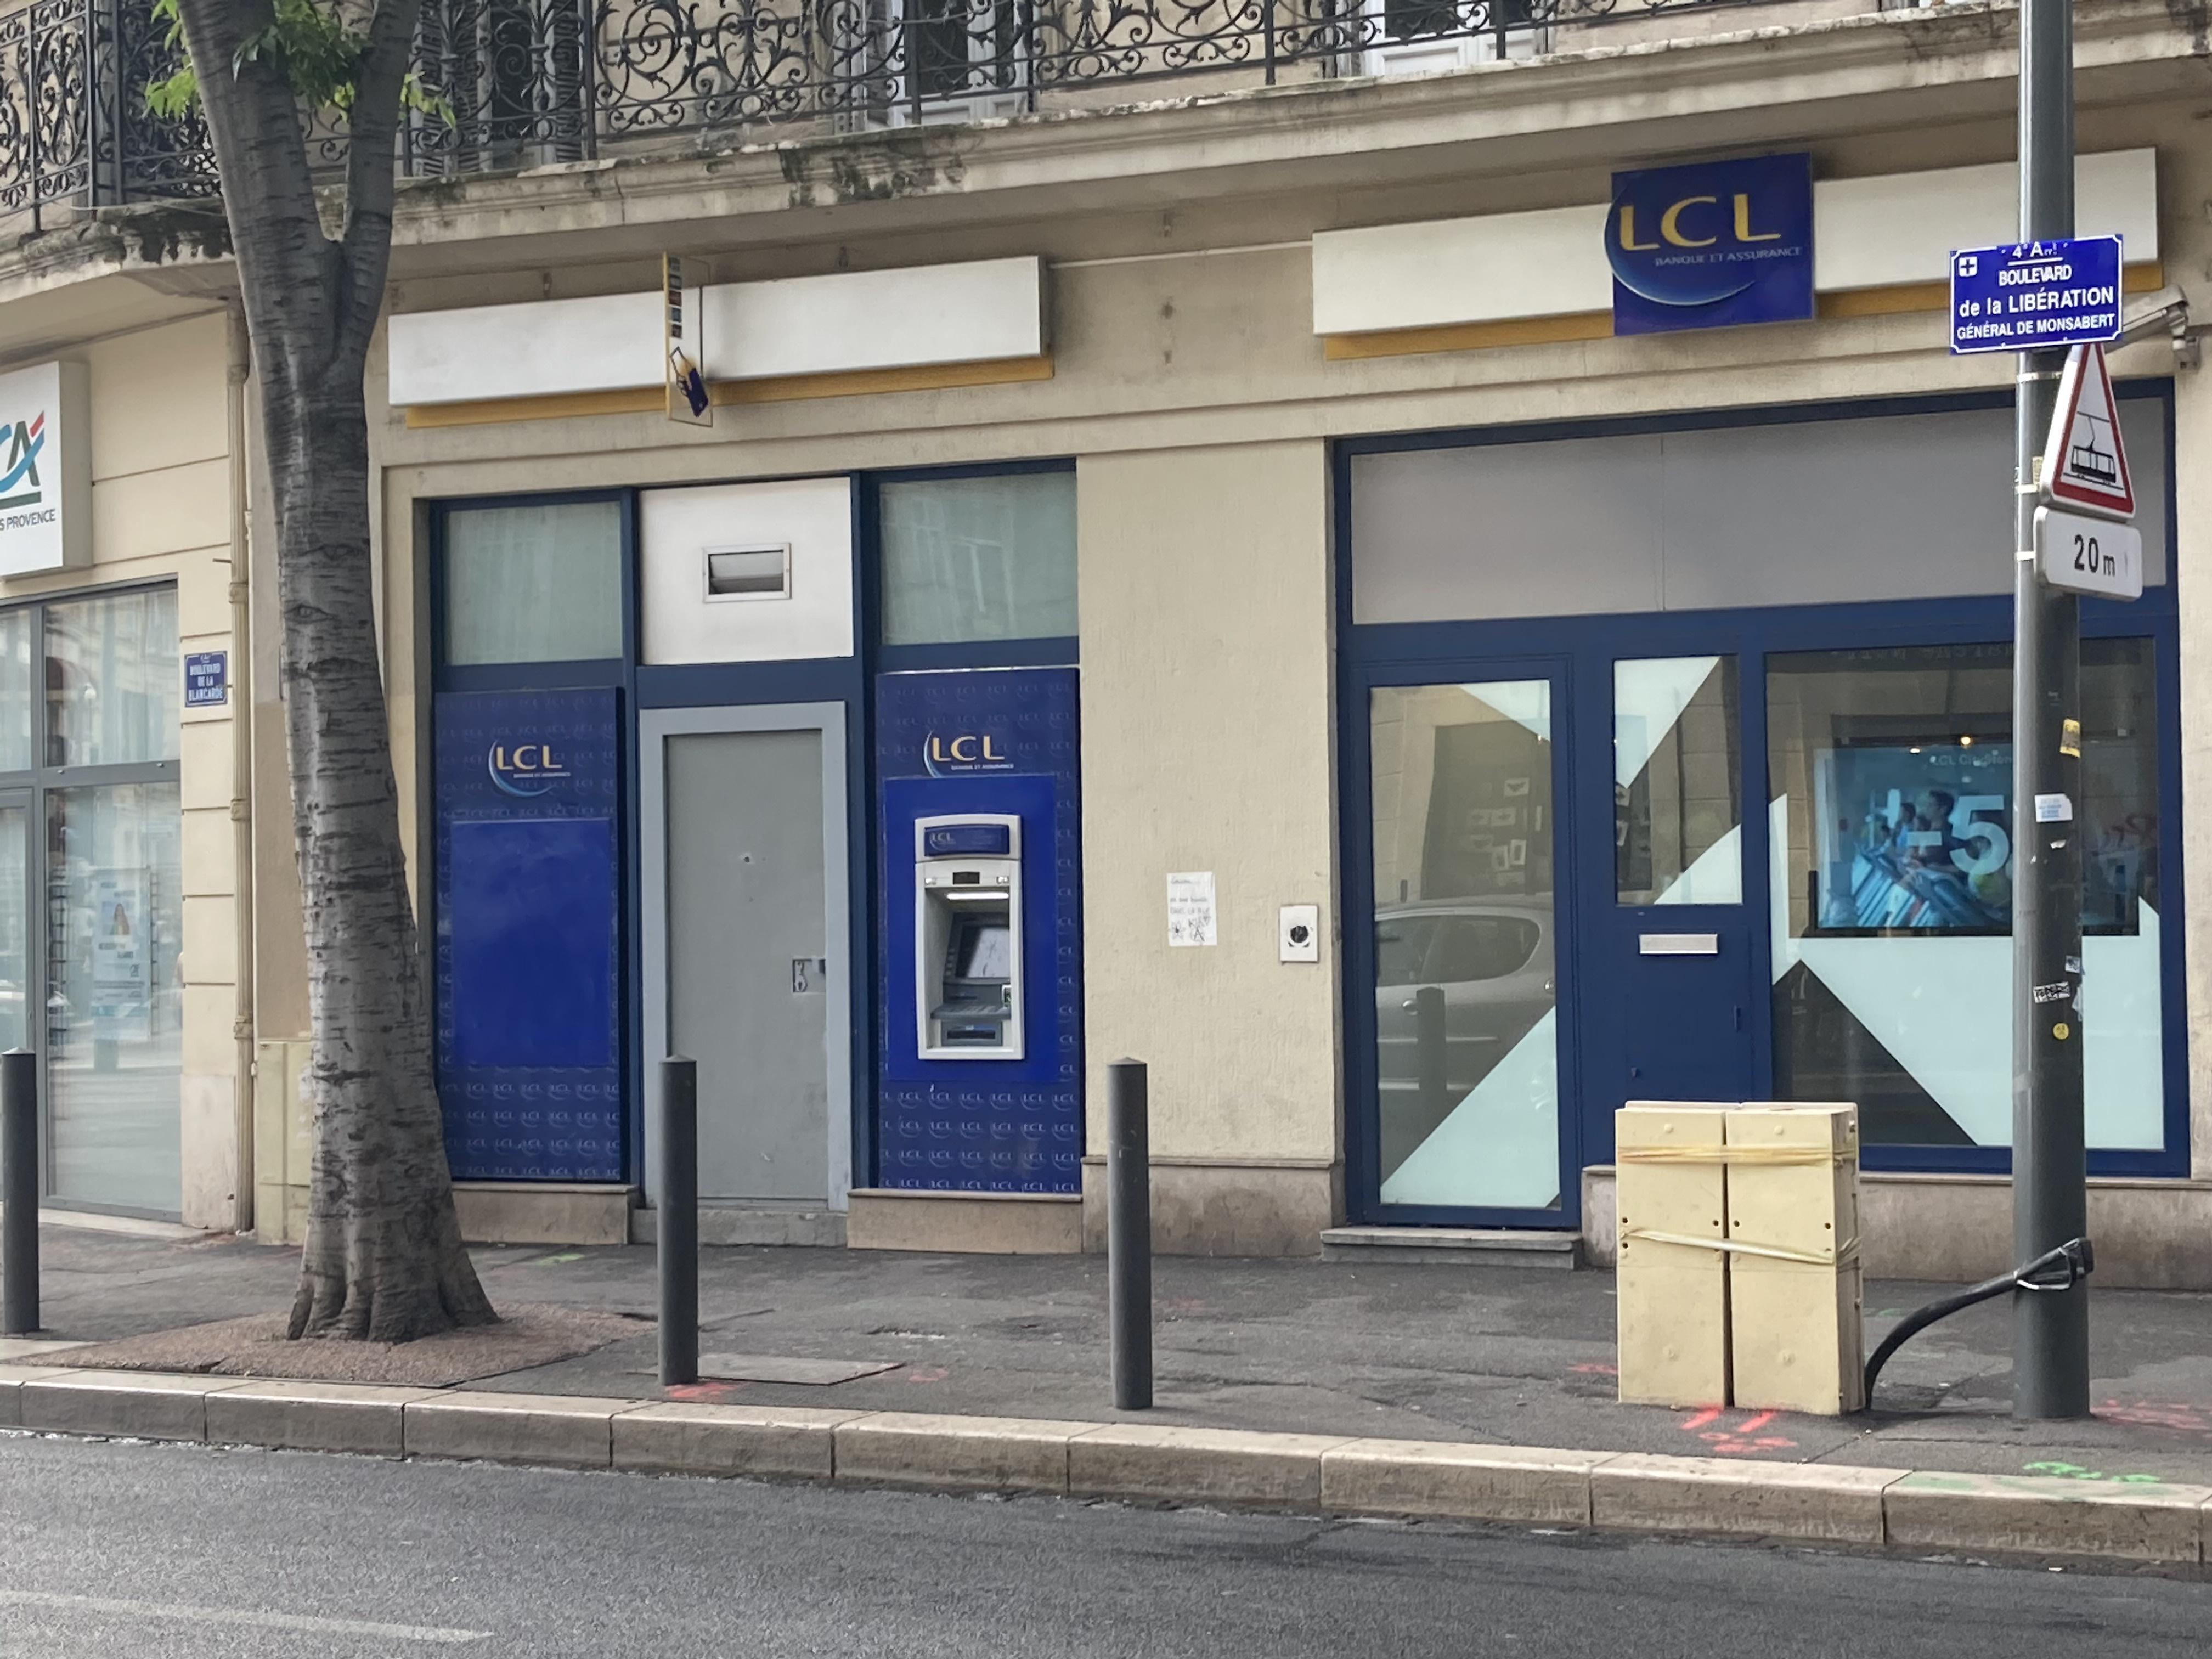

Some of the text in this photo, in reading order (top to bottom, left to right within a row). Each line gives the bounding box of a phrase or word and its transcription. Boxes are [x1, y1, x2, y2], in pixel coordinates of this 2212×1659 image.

[1620, 193, 1782, 251] LCL
[1654, 246, 1803, 267] BANQUE ET ASSURANCE
[1999, 265, 2072, 286] BOULEVARD
[1959, 286, 2114, 318] de la LIBÉRATION
[1956, 313, 2115, 341] GÉNÉRAL DE MONSABERT
[7, 508, 56, 530] PROVENCE
[2074, 534, 2115, 577] 20 m
[496, 745, 563, 770] LCL
[933, 735, 1005, 762] LCL
